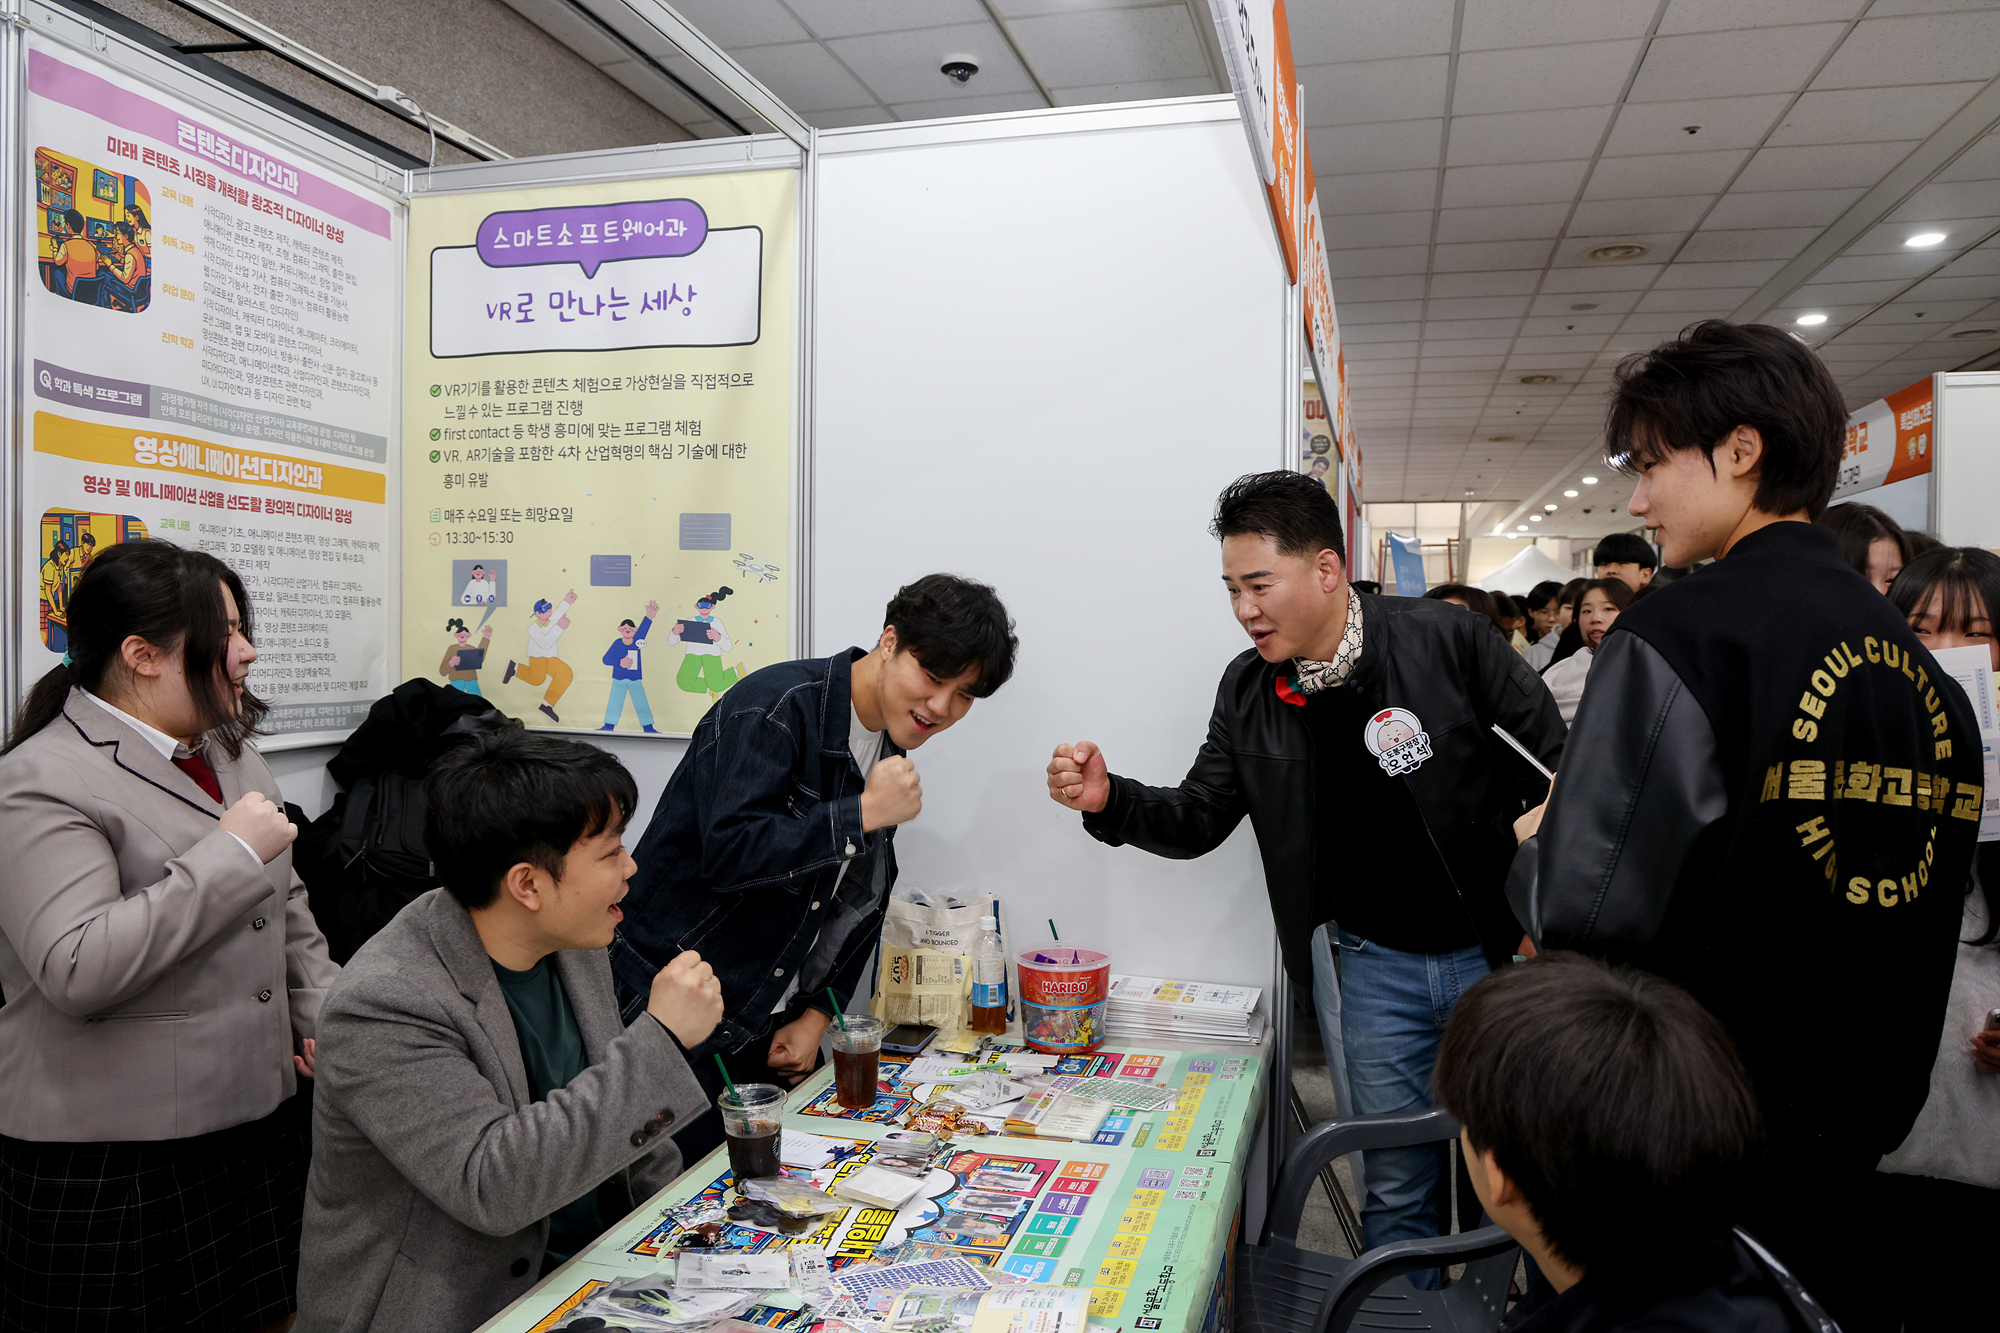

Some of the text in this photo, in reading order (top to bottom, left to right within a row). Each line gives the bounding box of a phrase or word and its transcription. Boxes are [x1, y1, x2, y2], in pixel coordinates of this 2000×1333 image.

[177, 119, 299, 196] 콘텐츠디자인과
[106, 135, 344, 244] 미래 콘텐츠 시장을 개척할 창조적 디자이너 양성
[161, 185, 194, 207] 교육 내용
[161, 234, 194, 254] 취득 자격
[203, 204, 344, 267] 시각디자인, 광고 콘텐츠 제작, 캐릭터 콘텐츠 제작,
[493, 218, 688, 249] 스마트소프트웨어과
[203, 218, 357, 286] 애니메이션 콘텐츠 제작, 조형, 컴퓨터 그래픽, 출판 편집,
[162, 283, 195, 302] 취업 분야
[203, 250, 349, 310] 시각 디자인 산업 기사, 컴퓨터 그래픽스 운용 기능사,
[236, 294, 268, 312] 일러스트,
[269, 303, 298, 321] 인디자인)
[486, 283, 698, 324] VR로 만나는 세상
[161, 331, 194, 349] 진학 학과
[202, 312, 323, 357] 모션 그래퍼, 앱 및 모바일 콘텐츠 디자이너,
[201, 344, 370, 398] 시각디자인과, 애니메이션학과, 산업디자인과, 콘텐츠디자인과,
[201, 359, 323, 399] 미디어디자인과, 영상콘텐츠 관련 디자인과,
[444, 372, 753, 396] VR기기를 활용한 콘텐츠 체험으로 가상현실을 직접적으로
[54, 377, 142, 406] 학과 특색 프로그램
[444, 399, 583, 420] 느낄 수 있는 프로그램 진행
[1303, 400, 1327, 420] OU
[443, 419, 701, 440] first contact 등 학생 흥미에 맞는 프로그램 체험
[133, 435, 323, 490] 영상애니메이션디자인과
[466, 446, 515, 462] AR기술을
[518, 445, 554, 461] 포함한
[557, 445, 581, 461] 4차
[585, 444, 644, 461] 산업혁명의
[648, 443, 672, 460] 핵심
[677, 443, 718, 460] 기술에
[721, 442, 747, 459] 대한
[442, 472, 488, 489] 흥미 유발
[83, 474, 352, 524] 영상 및 애니메이션 산업을 선도할 창의적 디자이너 양성
[159, 517, 190, 531] 교육 내용
[443, 506, 572, 523] 매주 수요일 또는 희망요일
[198, 523, 380, 552] 애니메이션 기초, 애니메이션 콘텐츠 제작, 영상 그래픽, 캐릭터 제작,
[446, 530, 513, 544] 13:30~15:30
[229, 542, 241, 553] 3D
[242, 543, 265, 556] 모델링
[267, 544, 274, 556] 및
[275, 546, 307, 559] 애니메이션,
[308, 548, 321, 560] 영상
[321, 550, 334, 562] 편집
[334, 551, 341, 562] 및
[342, 552, 365, 564] 특수효과,
[294, 652, 337, 663] 게임그래픽학과,
[294, 666, 331, 678] 영상예술학과,
[1792, 641, 1863, 742] SEOUL
[1863, 636, 1952, 761] CULTURE
[1386, 737, 1420, 759] 도봉구청장
[1795, 815, 1838, 894] HIG
[892, 956, 903, 985] 507
[1042, 981, 1088, 994] HARIBO
[836, 1208, 899, 1259] 내일을
